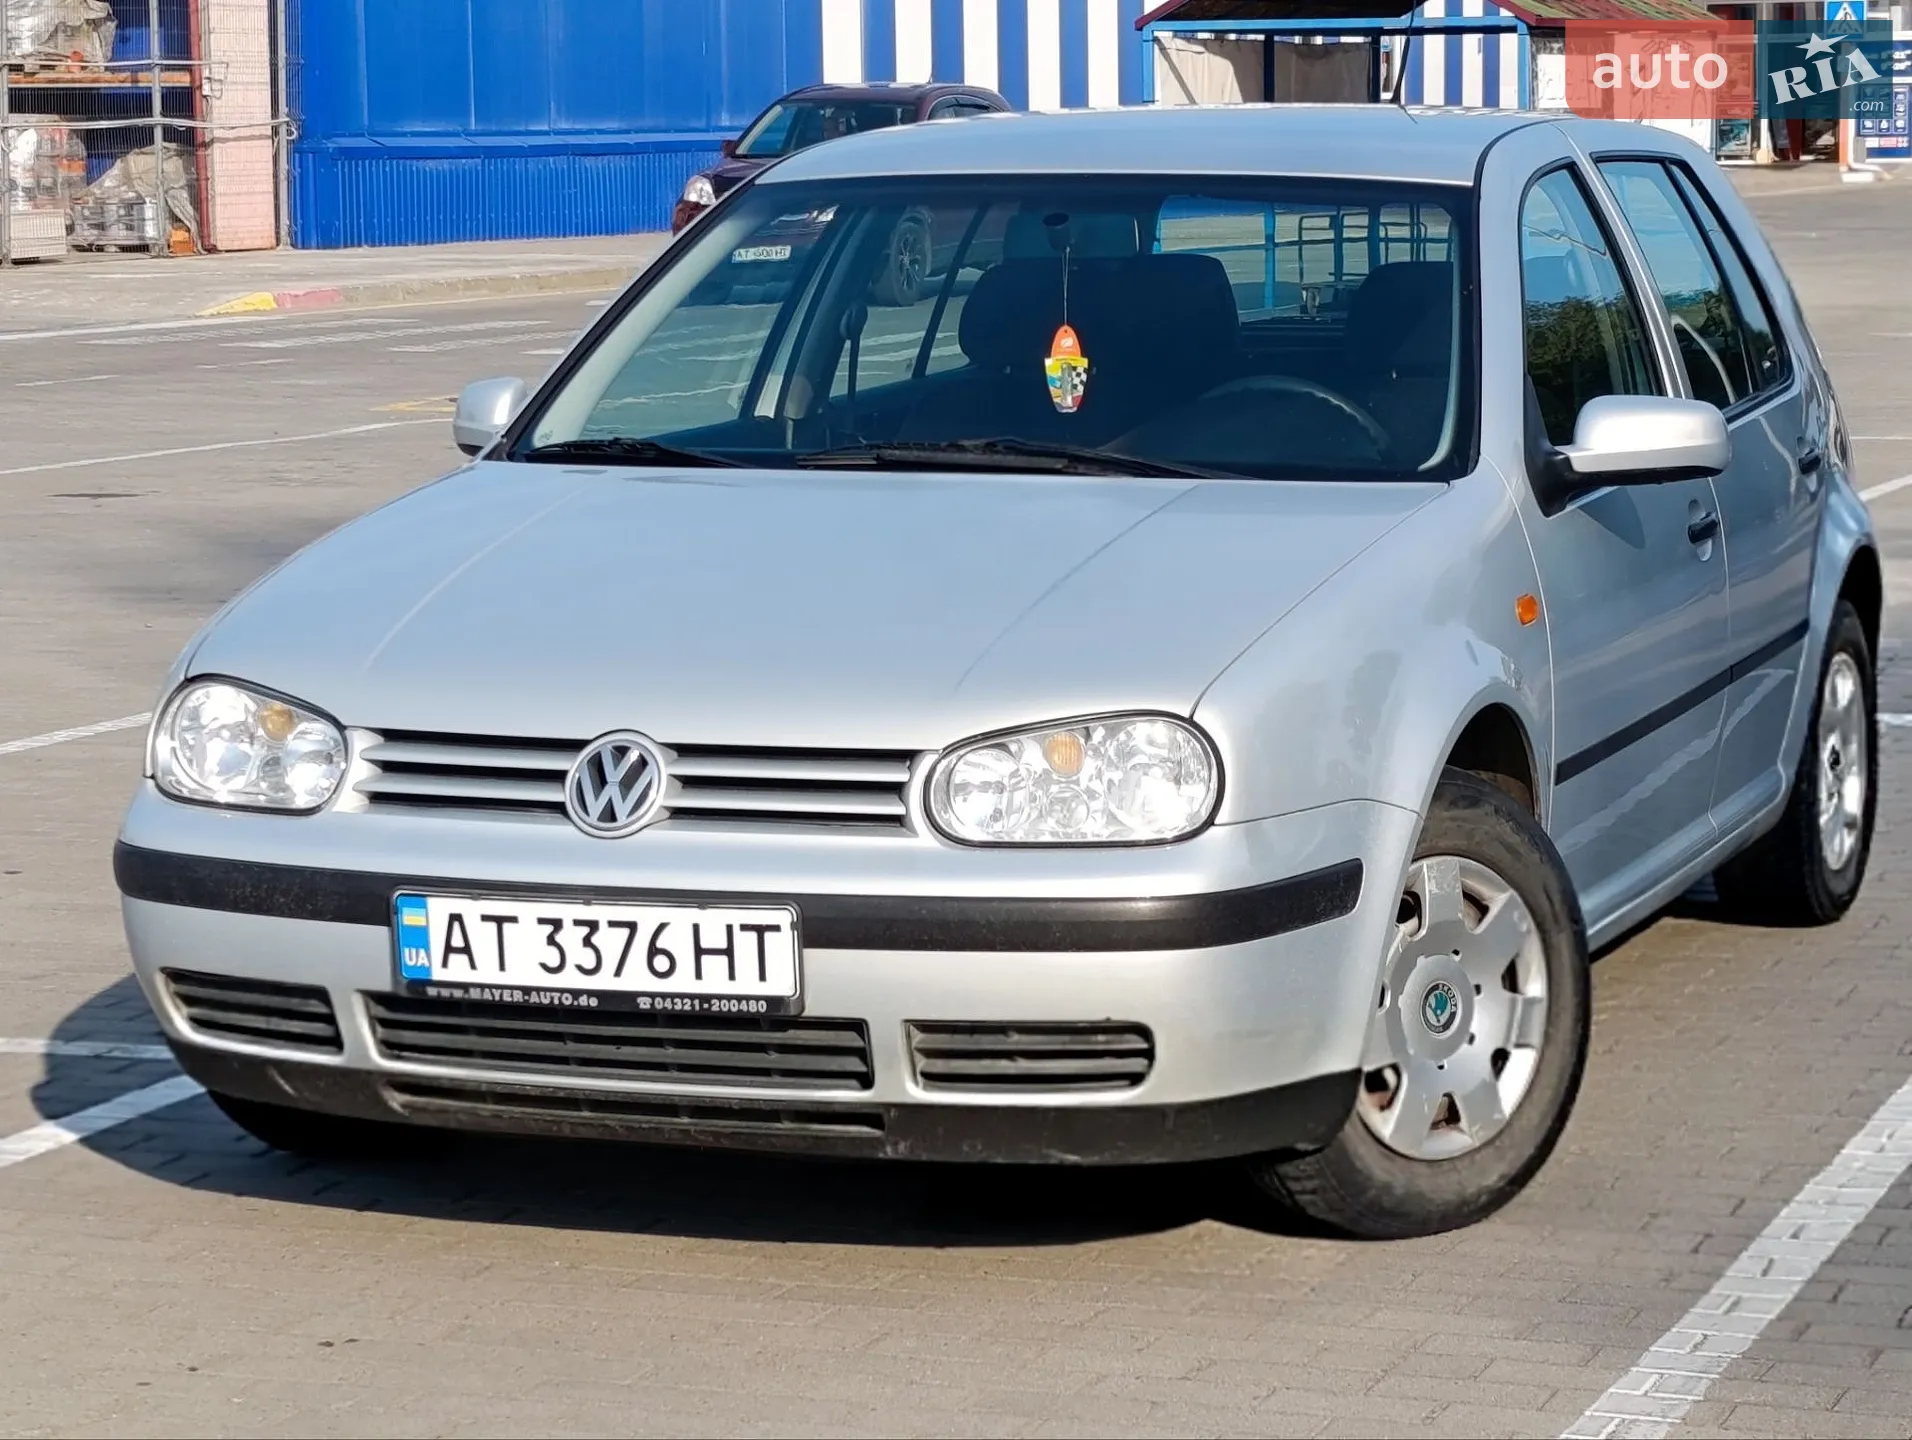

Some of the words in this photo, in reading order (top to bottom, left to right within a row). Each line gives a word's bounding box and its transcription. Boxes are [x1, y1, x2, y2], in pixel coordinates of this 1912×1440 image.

[404, 947, 431, 967] UA
[441, 911, 519, 973] AT
[536, 916, 678, 981] 3376
[691, 921, 782, 983] HT
